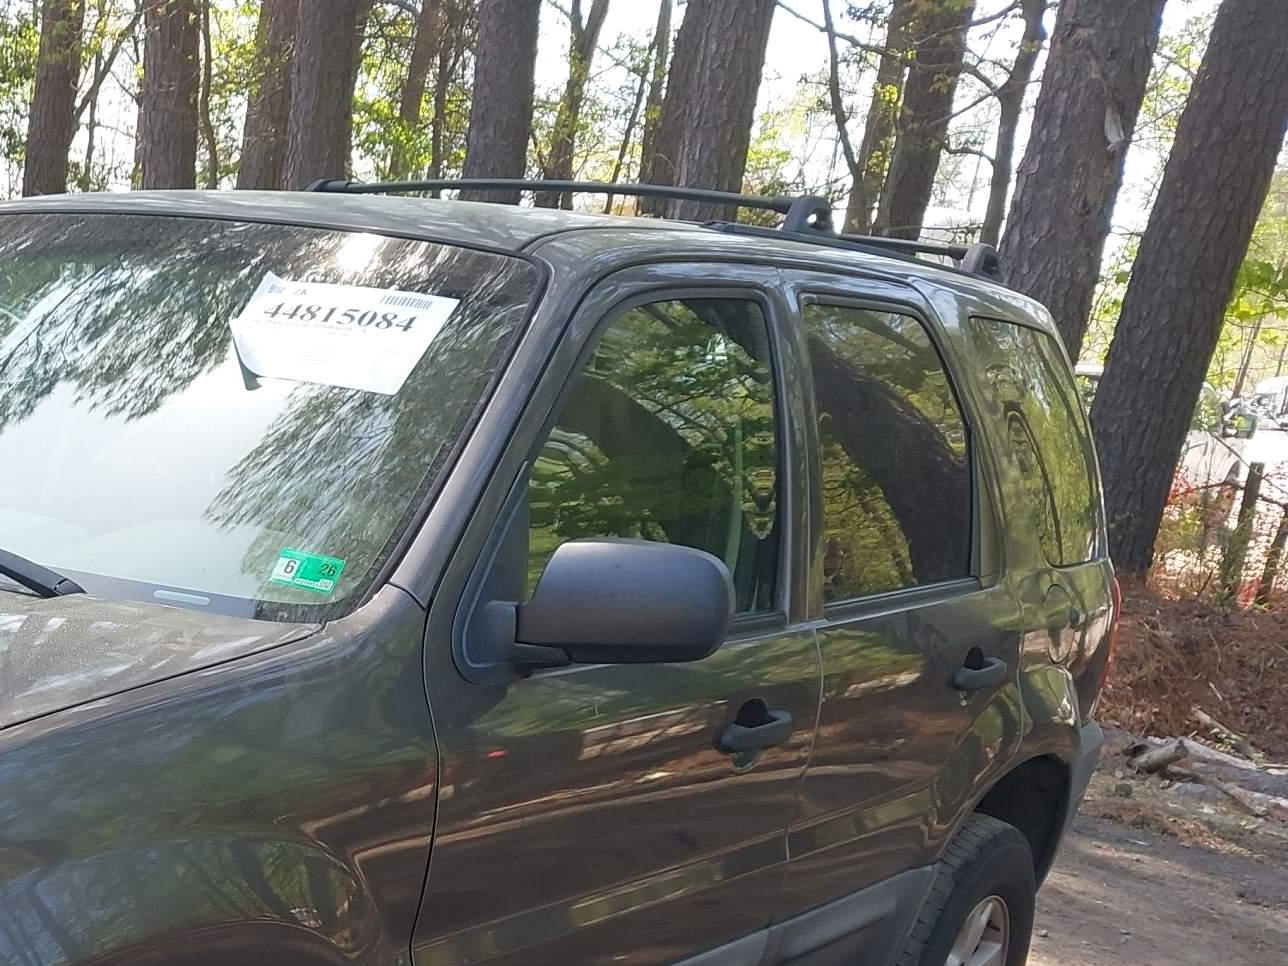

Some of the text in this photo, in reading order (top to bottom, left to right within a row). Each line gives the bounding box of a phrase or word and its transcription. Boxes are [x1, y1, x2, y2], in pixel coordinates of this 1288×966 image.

[264, 302, 418, 333] 44815084
[283, 560, 338, 577] 6 26
